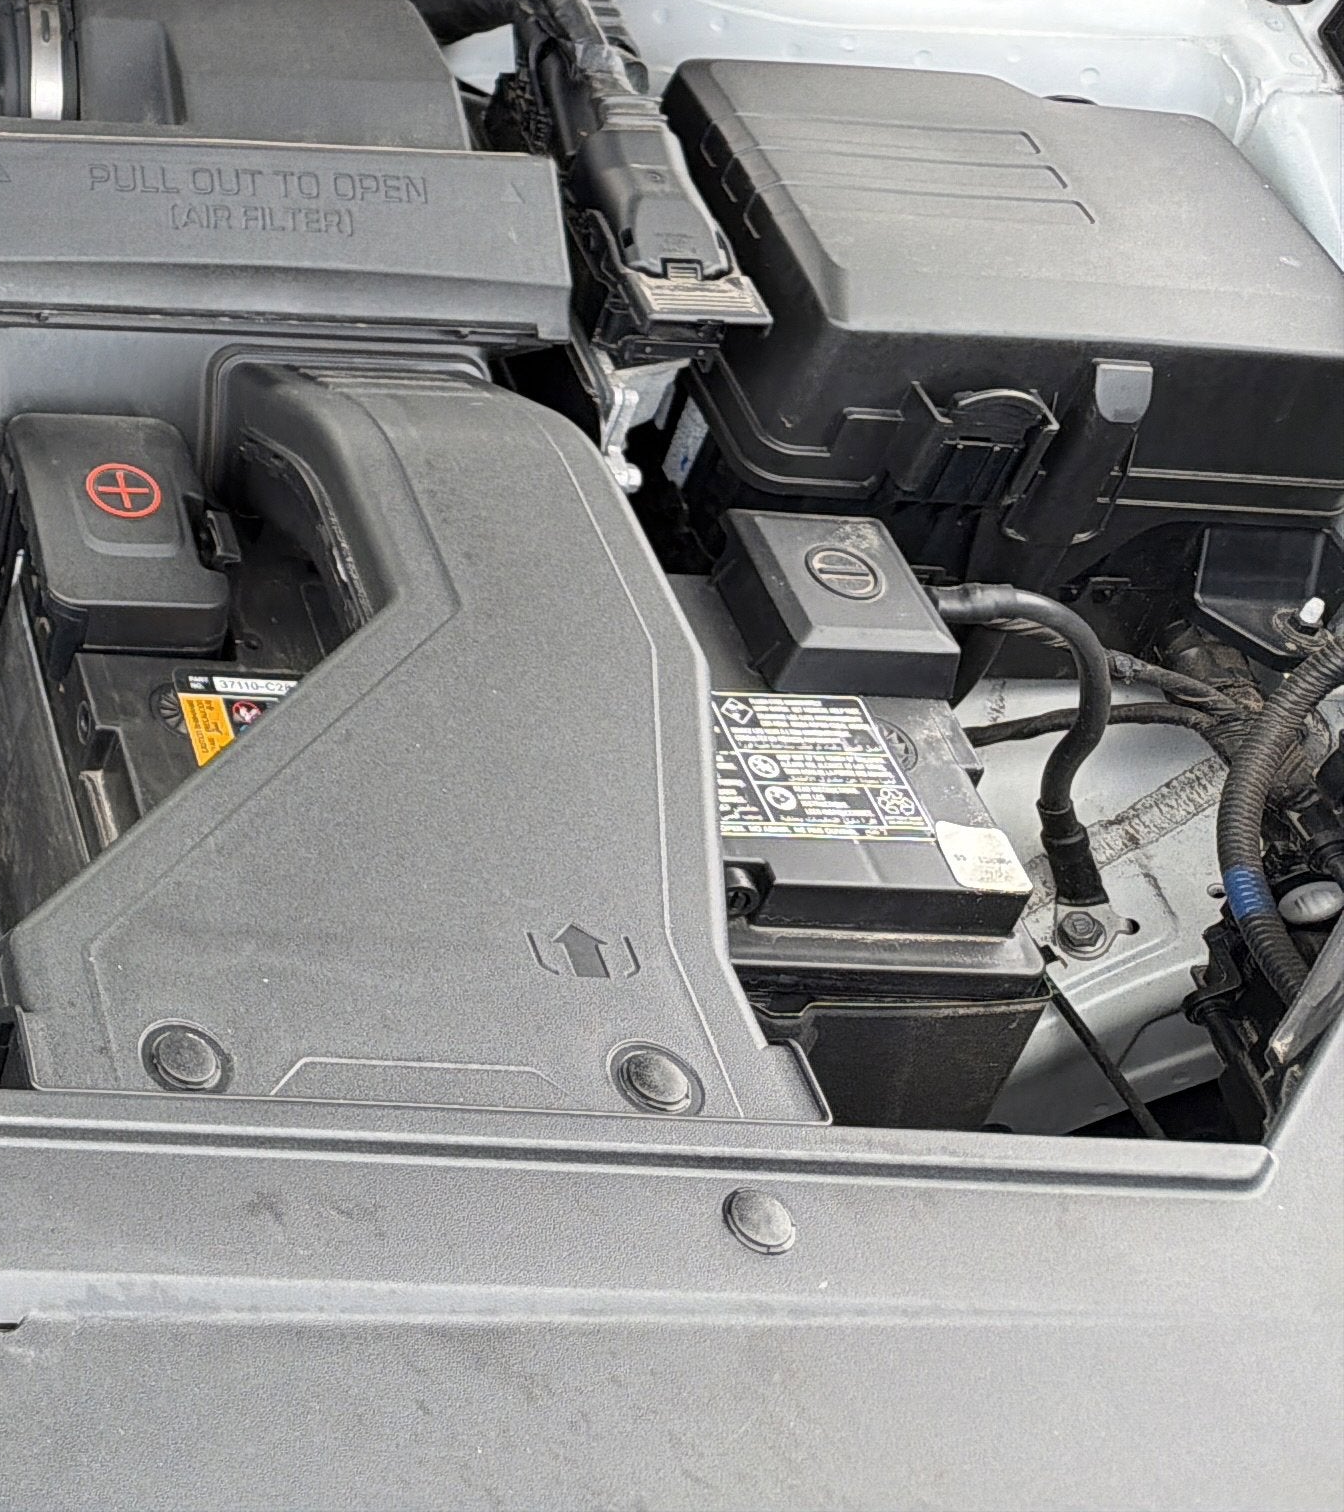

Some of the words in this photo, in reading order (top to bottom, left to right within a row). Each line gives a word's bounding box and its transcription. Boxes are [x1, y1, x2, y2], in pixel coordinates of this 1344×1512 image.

[87, 163, 181, 194] PULL
[193, 167, 263, 197] OUT
[272, 170, 321, 200] TO
[333, 172, 430, 204] OPEN
[170, 202, 234, 230] (AIR
[241, 206, 355, 237] FILTER)
